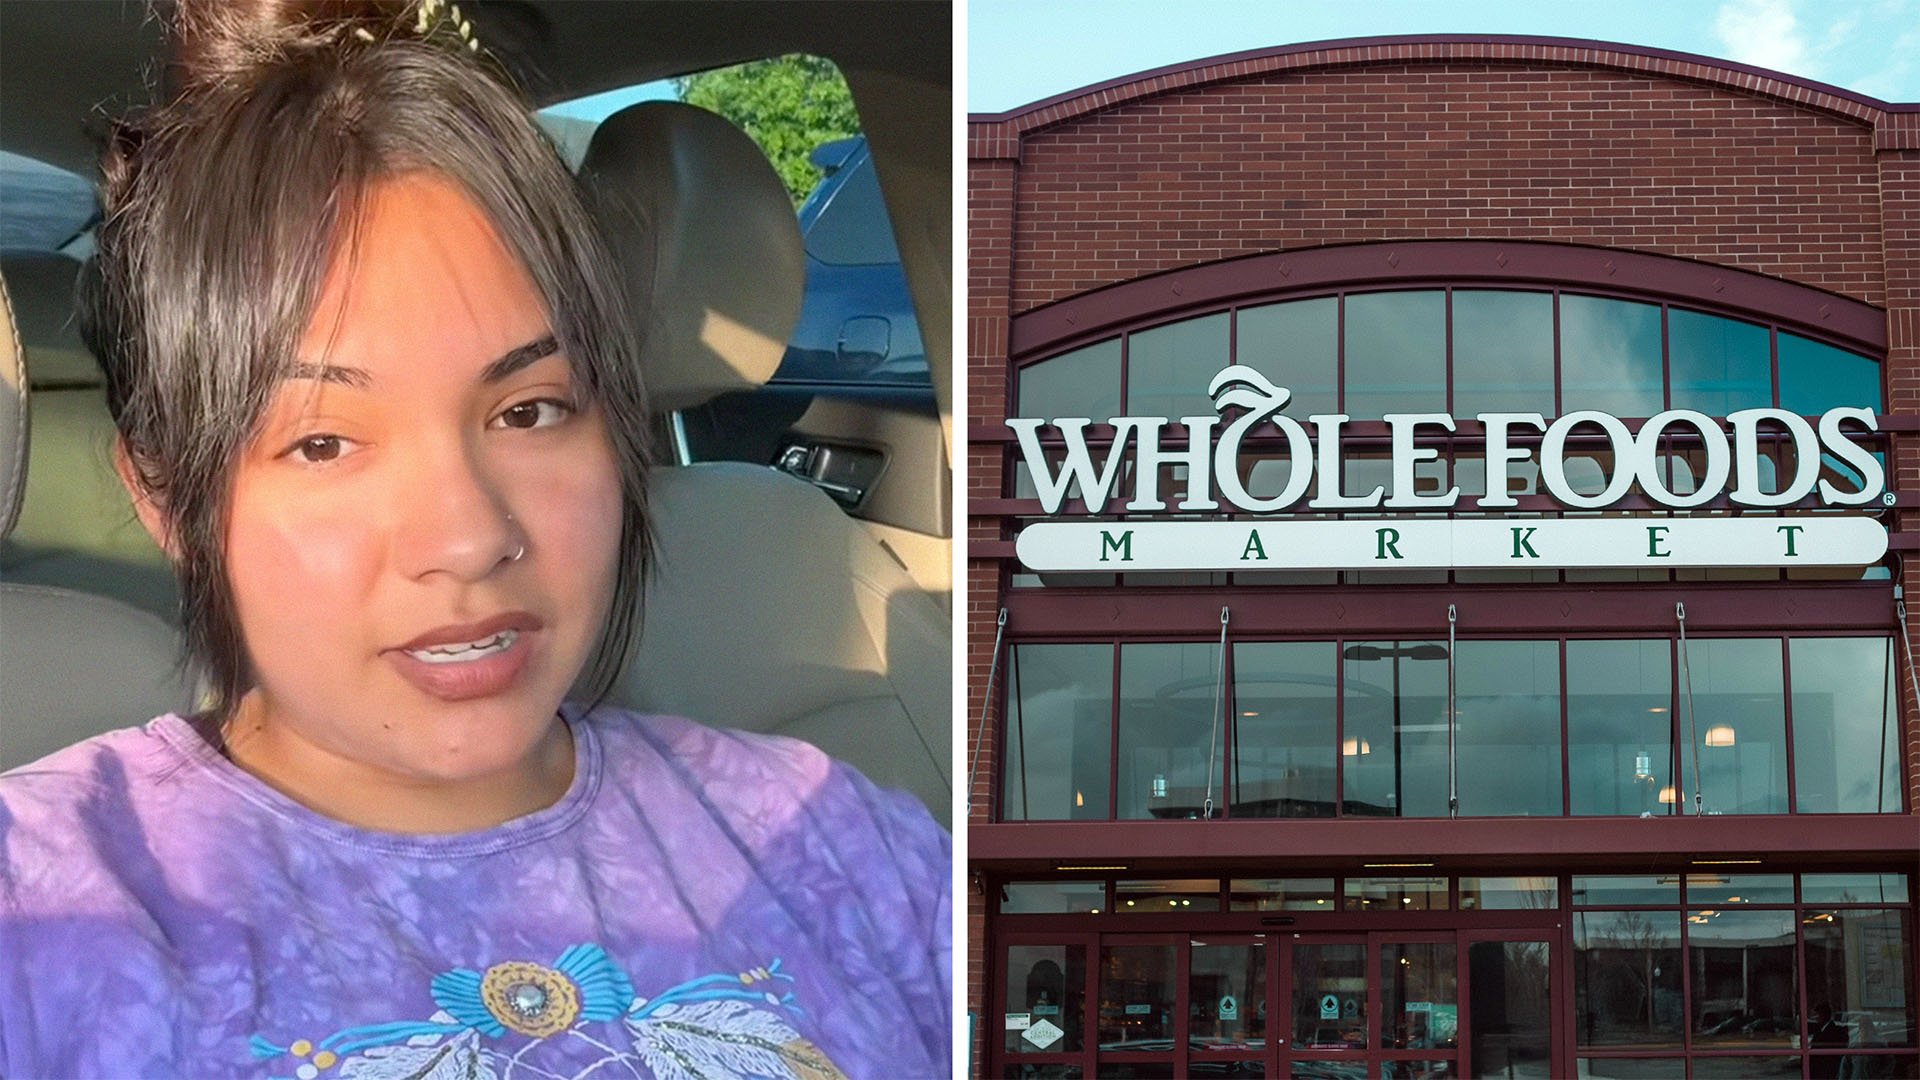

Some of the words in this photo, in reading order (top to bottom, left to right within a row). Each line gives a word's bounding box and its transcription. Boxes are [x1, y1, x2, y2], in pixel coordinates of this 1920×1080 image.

[1004, 364, 1461, 515] WHOLE
[1476, 406, 1886, 509] FOODS
[1099, 525, 1804, 562] MARKET
